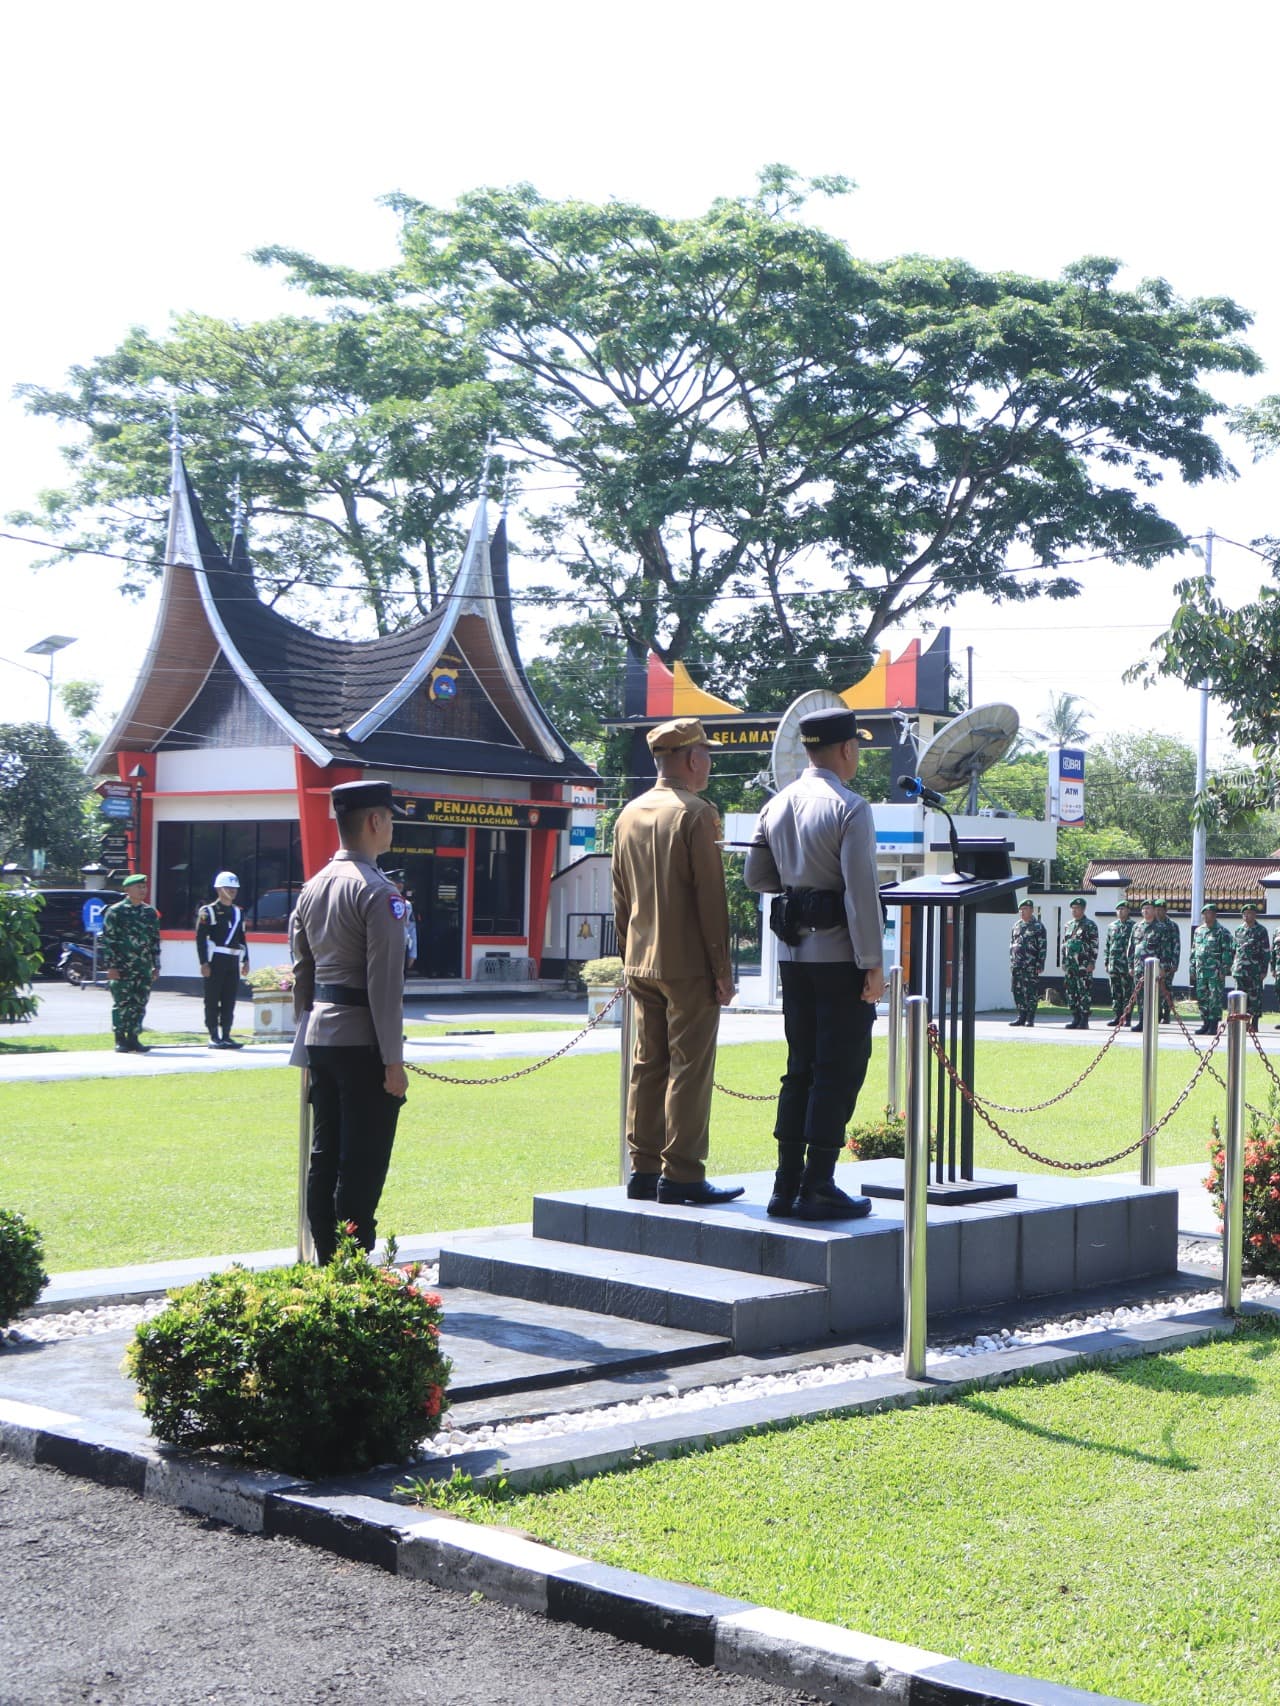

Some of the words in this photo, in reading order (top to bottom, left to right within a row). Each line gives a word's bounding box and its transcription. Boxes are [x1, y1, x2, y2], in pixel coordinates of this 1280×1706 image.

[712, 730, 776, 744] SELAMAT
[1065, 788, 1079, 796] ATM
[434, 801, 513, 817] PENJAGAAN
[427, 813, 478, 825] WICAKSANA
[571, 828, 586, 837] ATM
[90, 905, 102, 923] P
